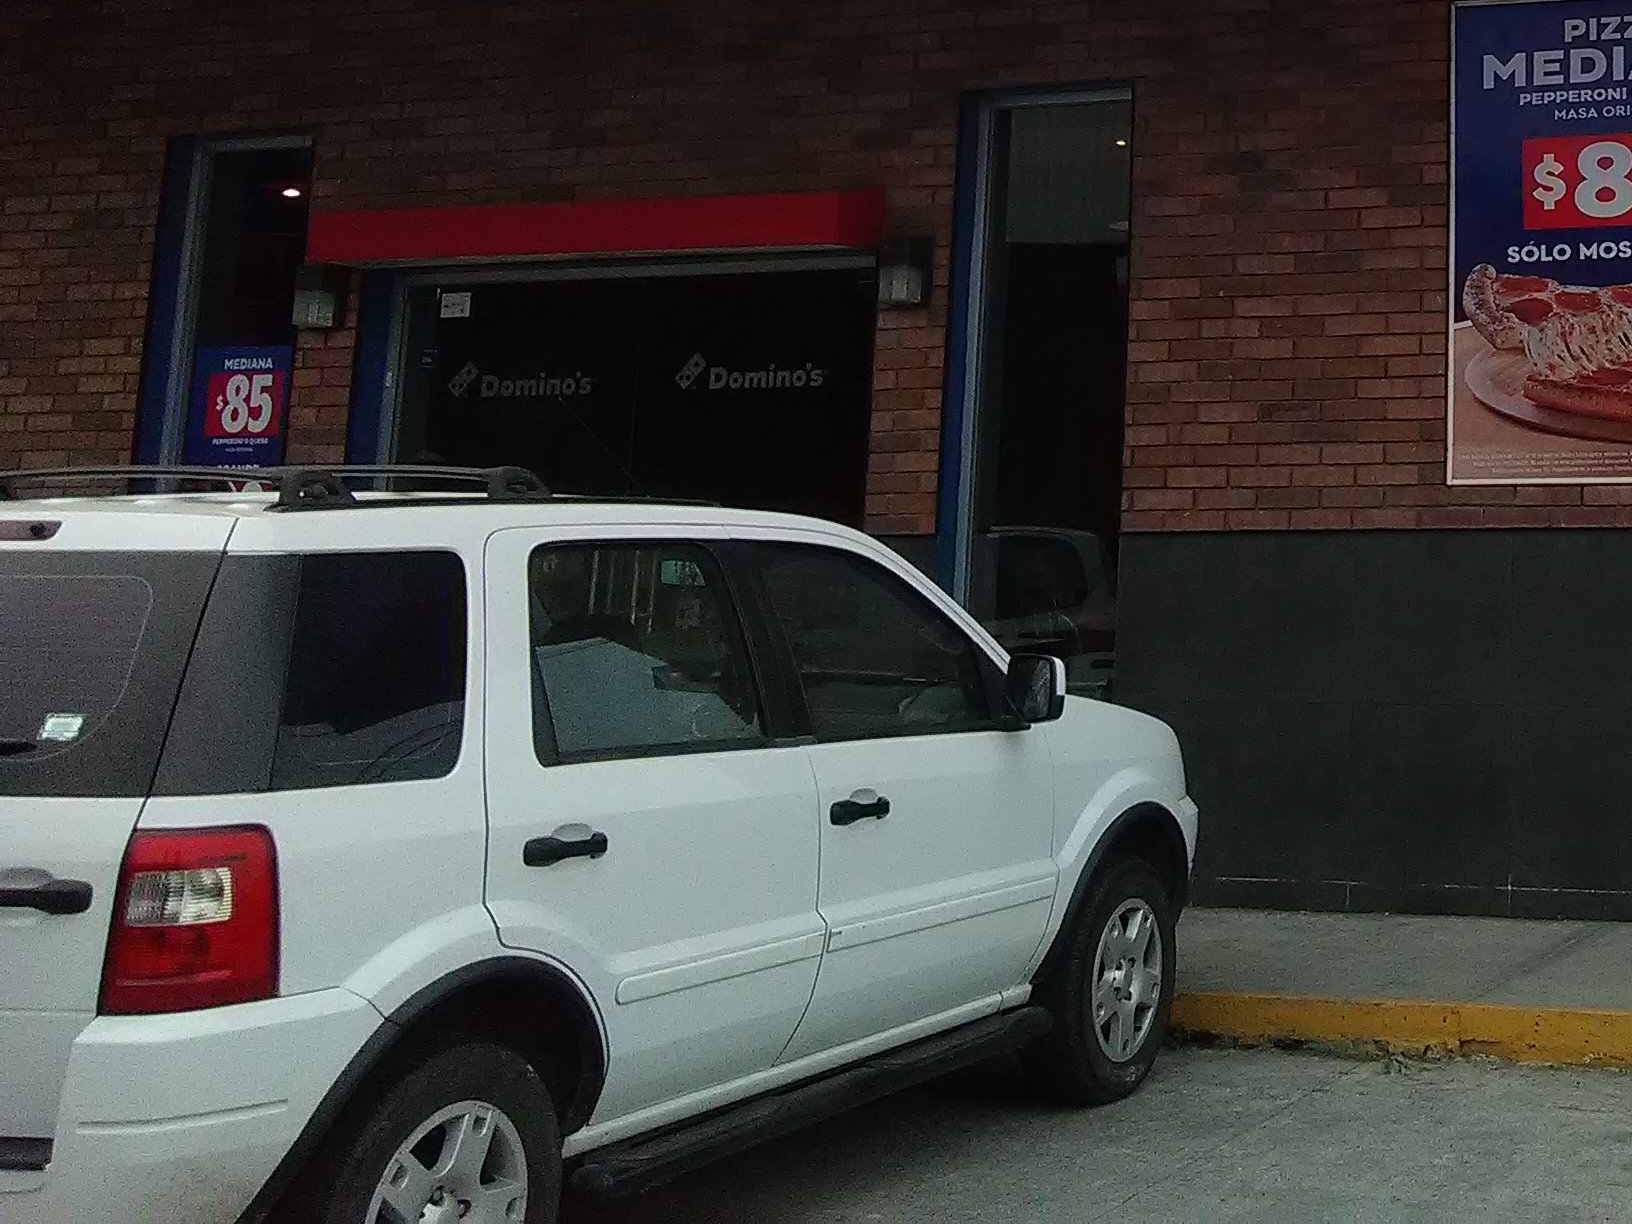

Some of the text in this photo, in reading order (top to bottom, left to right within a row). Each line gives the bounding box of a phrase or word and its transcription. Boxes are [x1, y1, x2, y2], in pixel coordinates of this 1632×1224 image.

[1519, 86, 1628, 106] PEPPERONI
[1553, 106, 1599, 121] MASA
[1506, 240, 1572, 264] SÓLO
[224, 358, 273, 370] MEDIANA
[480, 371, 593, 399] Domino's
[708, 363, 824, 390] Domino's
[215, 374, 273, 433] $85
